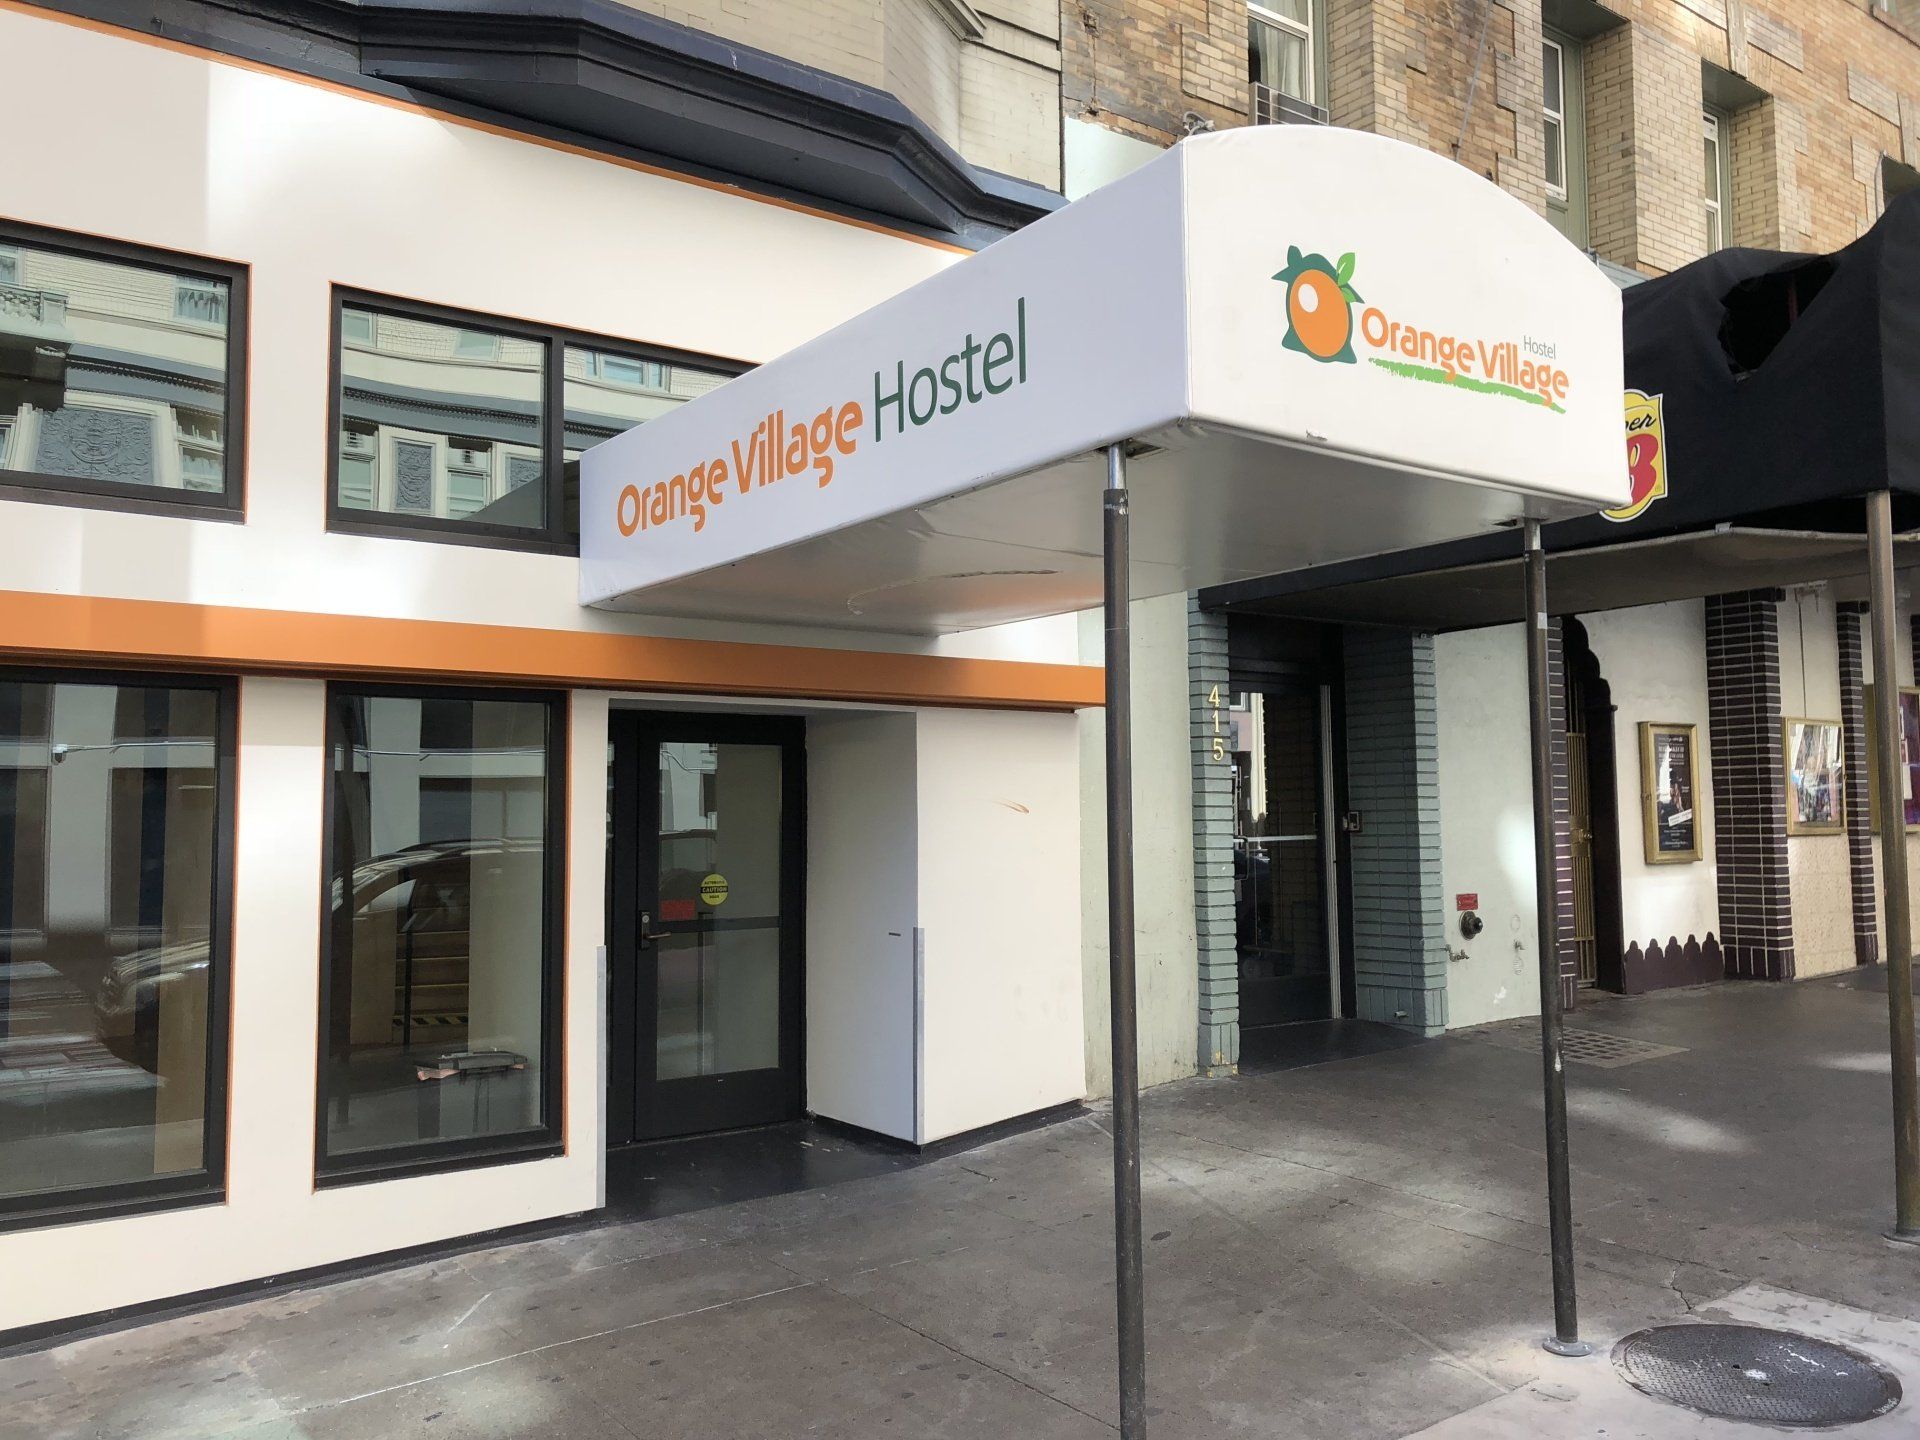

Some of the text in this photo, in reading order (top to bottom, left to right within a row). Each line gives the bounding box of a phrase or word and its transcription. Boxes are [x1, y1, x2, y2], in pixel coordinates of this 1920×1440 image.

[1361, 307, 1570, 407] Orange Village
[1523, 335, 1556, 360] Hostel
[617, 296, 1027, 537] Orange Village Hostel
[1625, 413, 1656, 432] er
[1208, 684, 1224, 761] 415
